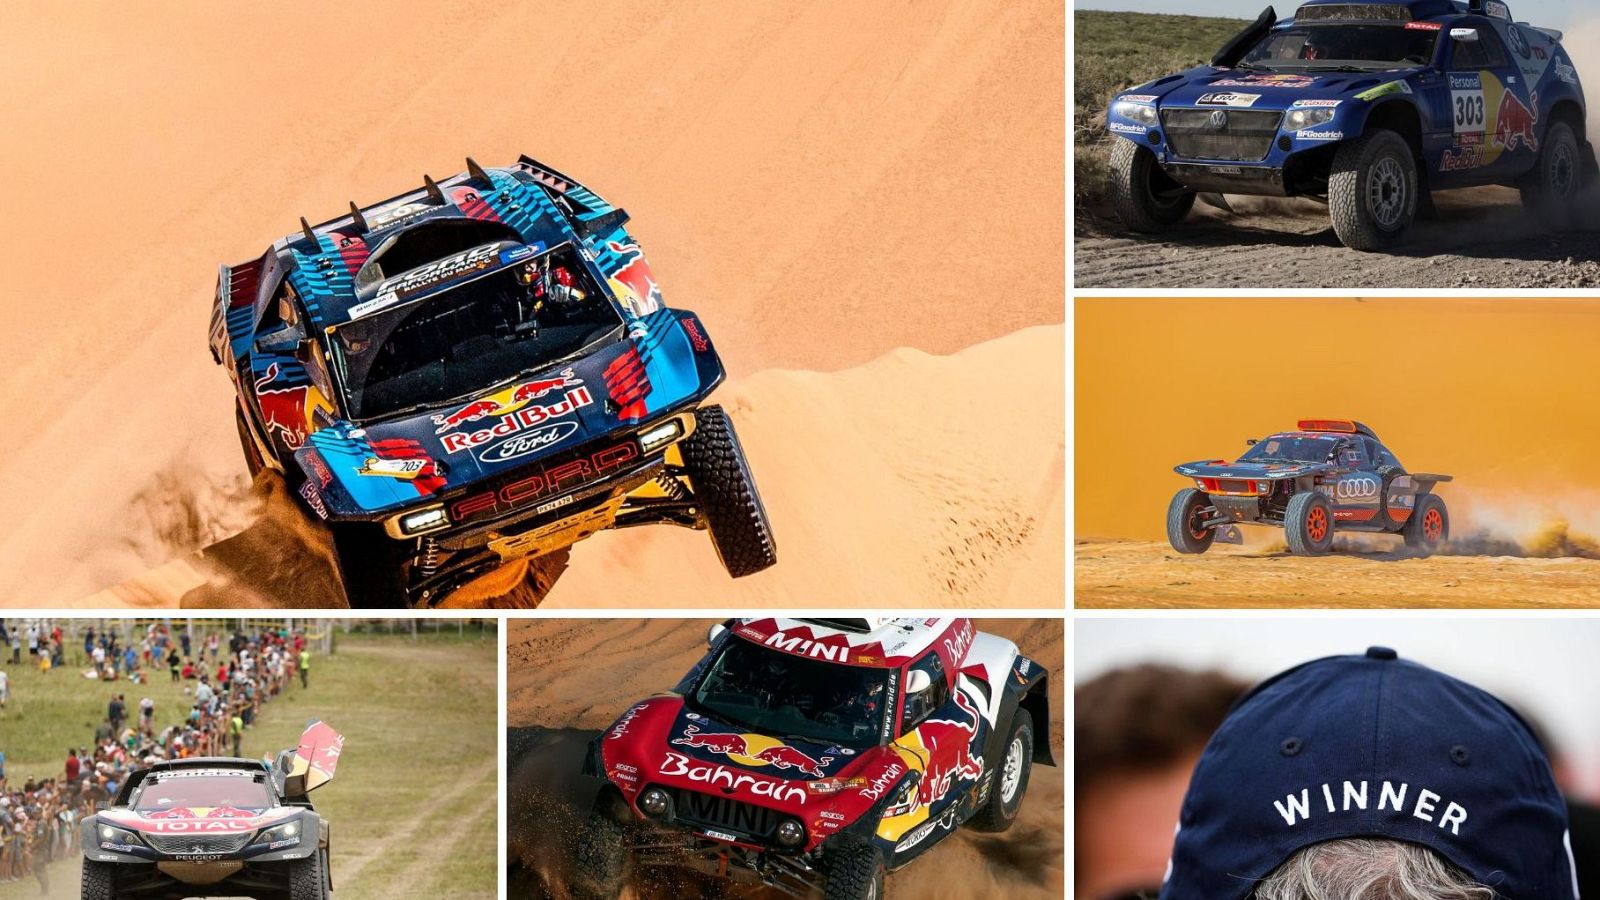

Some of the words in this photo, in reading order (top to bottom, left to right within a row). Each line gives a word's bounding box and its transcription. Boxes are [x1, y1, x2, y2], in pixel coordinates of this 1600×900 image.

[1450, 75, 1479, 88] Personal
[1456, 96, 1483, 126] 303
[1110, 122, 1147, 134] BFGoodrich
[1296, 130, 1343, 140] BFGoodrich
[404, 276, 439, 292] RALLYE
[441, 269, 454, 278] DU
[440, 418, 518, 454] Red
[517, 386, 594, 428] Bull
[500, 430, 559, 457] Ford
[400, 461, 422, 471] 203
[451, 440, 638, 521] FORD
[765, 632, 849, 662] MINI
[884, 674, 897, 737] www.x-raid.de
[659, 753, 806, 805] Bahrain
[859, 763, 902, 801] Bahrain
[1274, 780, 1468, 836] WINNER
[154, 821, 247, 831] TOTAL
